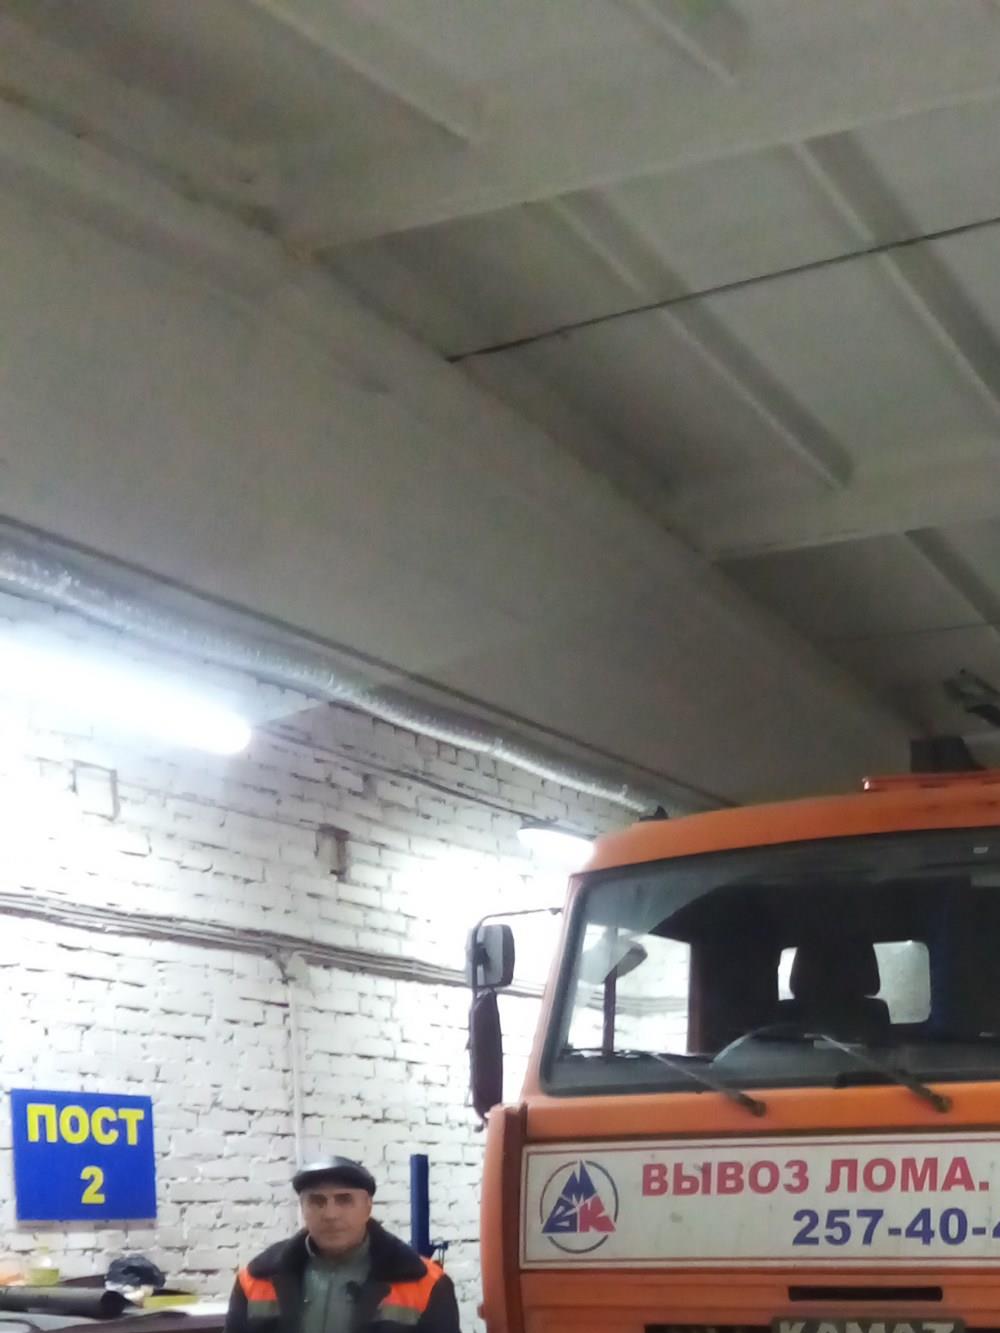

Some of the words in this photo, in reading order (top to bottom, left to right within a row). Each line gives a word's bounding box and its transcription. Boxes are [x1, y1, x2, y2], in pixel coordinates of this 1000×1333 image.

[27, 1103, 145, 1145] ПОСТ
[80, 1166, 106, 1204] 2
[641, 1159, 810, 1198] ВЫВОЗ
[825, 1157, 989, 1195] ЛОМА.
